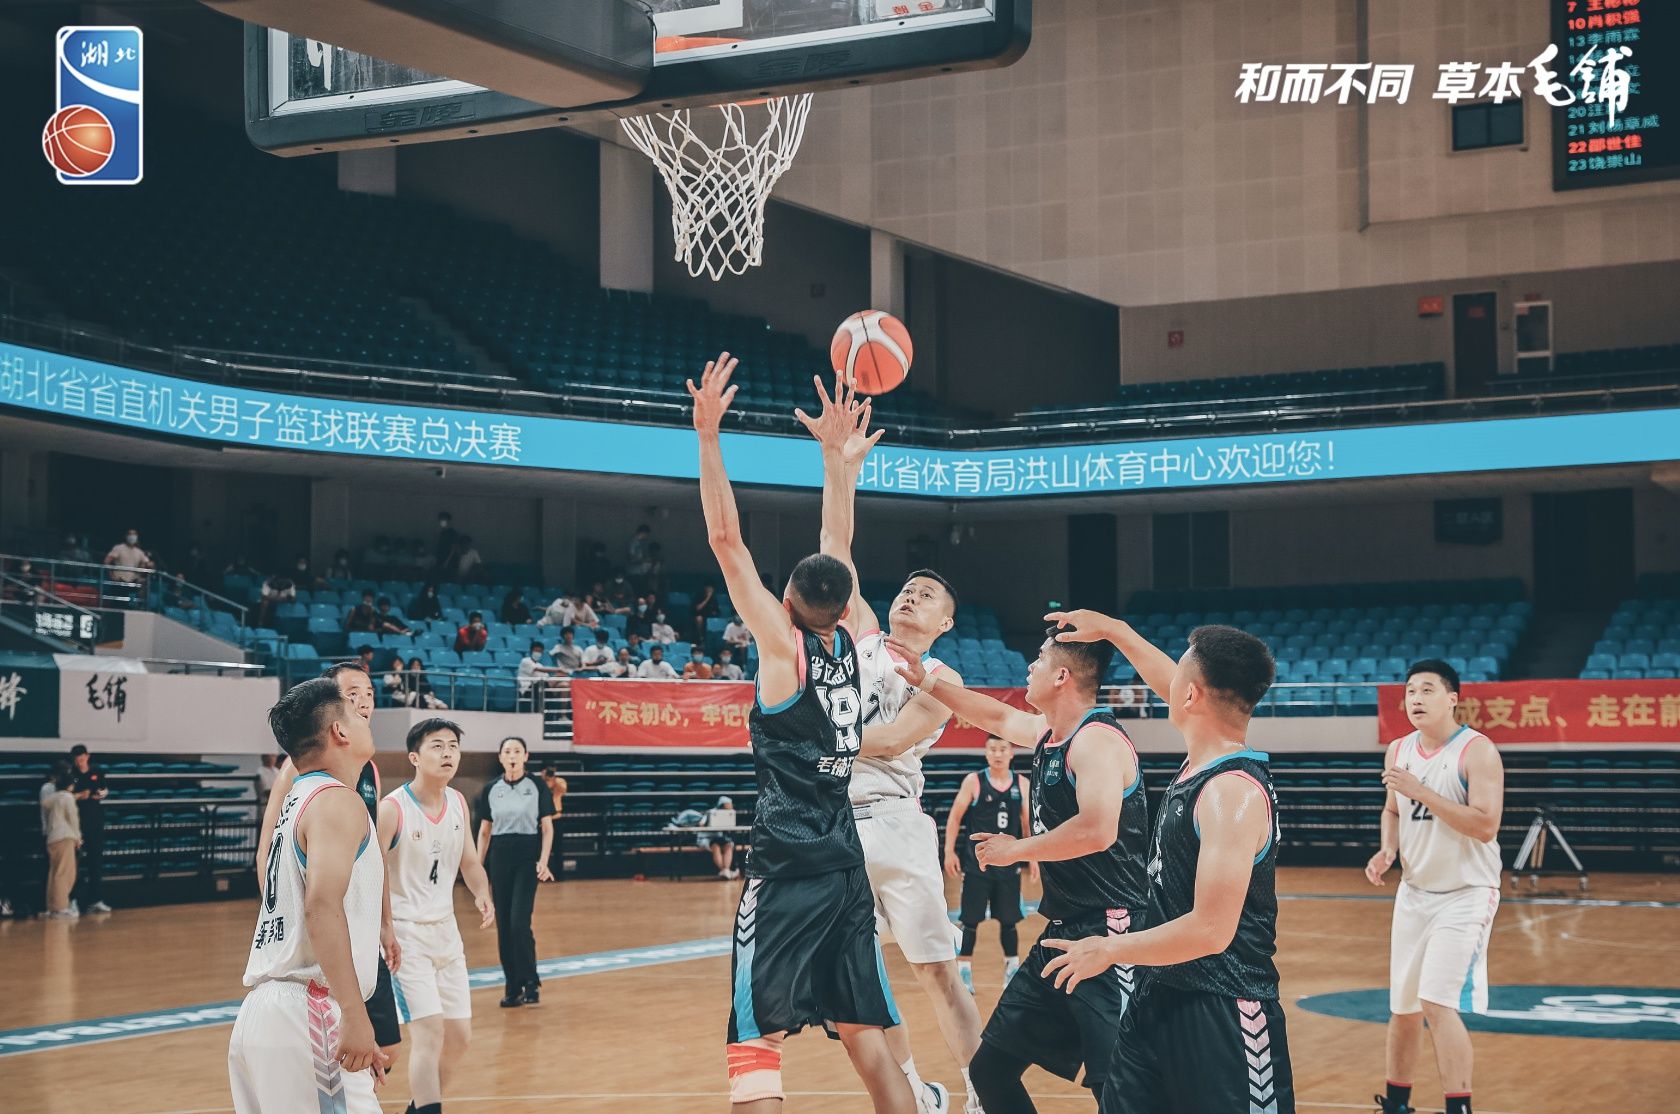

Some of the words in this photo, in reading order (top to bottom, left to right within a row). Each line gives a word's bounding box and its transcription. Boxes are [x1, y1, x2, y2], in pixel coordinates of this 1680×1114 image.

[1567, 1, 1577, 13] 7
[1568, 18, 1586, 30] 10
[1568, 35, 1586, 47] 13
[1568, 106, 1587, 119] 20
[1568, 124, 1585, 136] 21
[1568, 141, 1587, 154] 22
[1568, 159, 1587, 172] 23
[997, 812, 1008, 829] 6
[429, 859, 439, 885] 4
